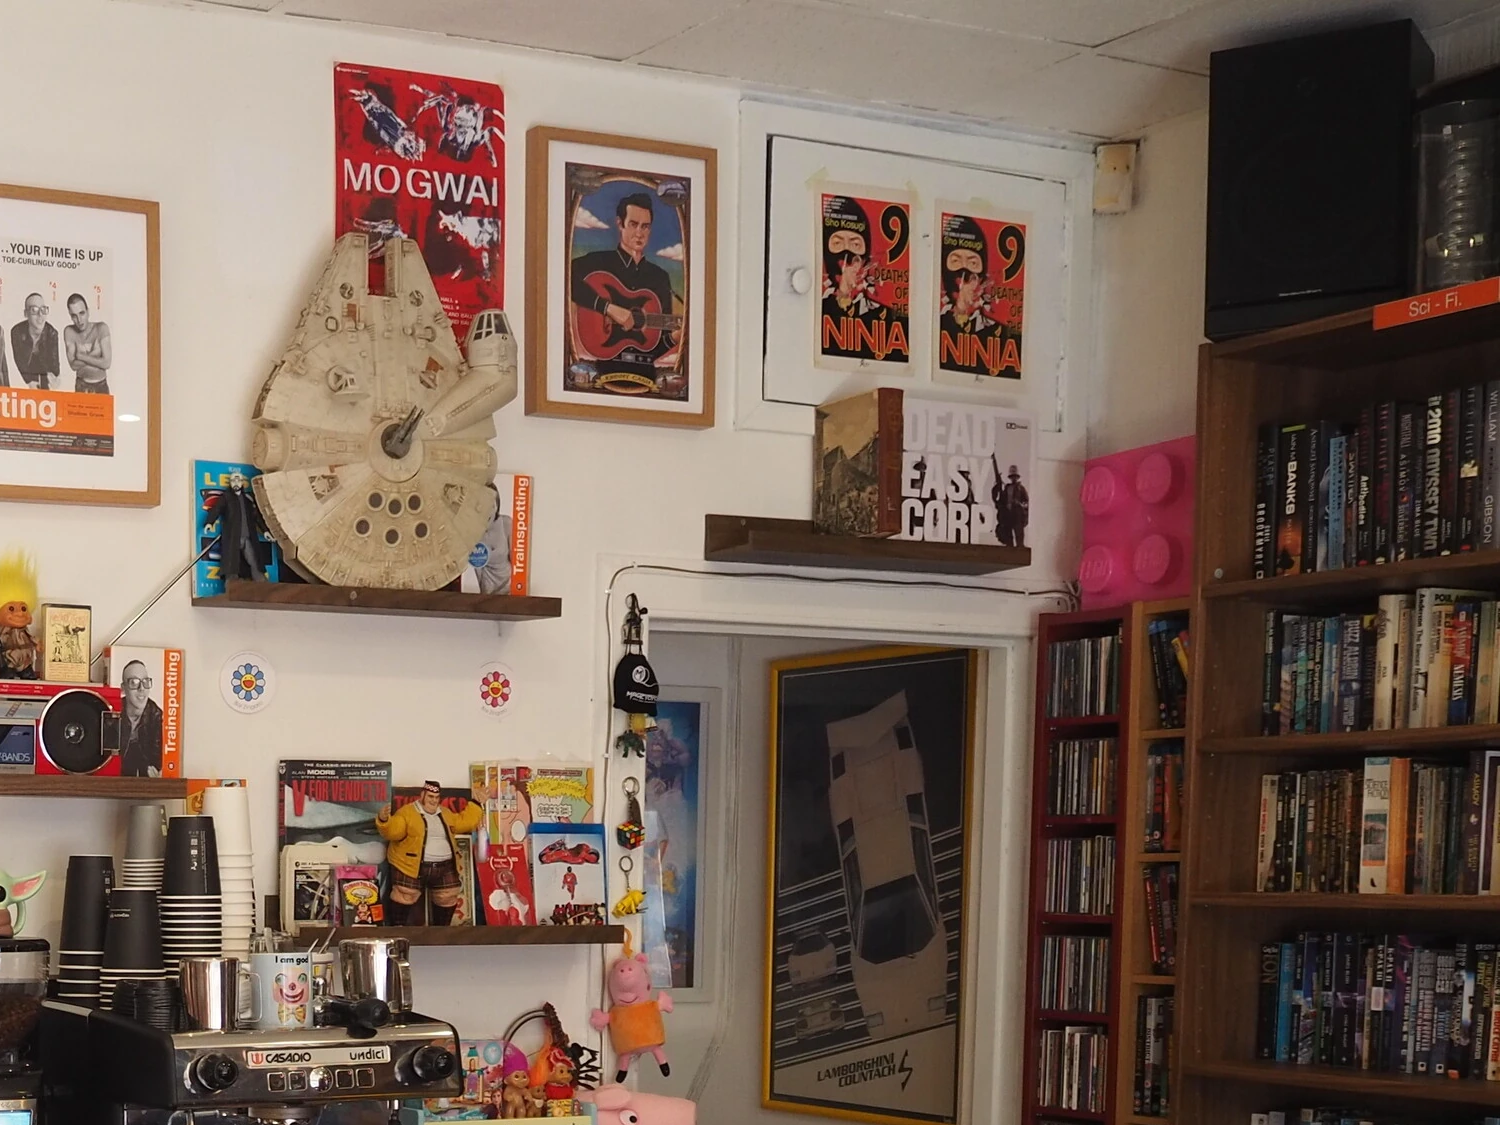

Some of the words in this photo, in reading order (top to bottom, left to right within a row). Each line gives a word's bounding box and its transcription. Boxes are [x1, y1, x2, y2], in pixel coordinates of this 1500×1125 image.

[342, 158, 499, 208] MOGWAI
[44, 246, 71, 259] TIME
[74, 249, 85, 260] IS
[88, 251, 104, 262] UP
[880, 204, 910, 264] 9
[997, 224, 1025, 283] 9
[2, 255, 55, 268] TOE-CURLINGLY
[1409, 302, 1430, 317] Sci
[1445, 292, 1462, 308] Fi.
[903, 409, 995, 458] DEAD
[1488, 390, 1499, 442] WILLIAM
[902, 452, 994, 504] EASY
[1286, 461, 1298, 515] BANKS
[513, 476, 529, 577] Trainspotting
[901, 499, 998, 544] CORP
[1484, 495, 1494, 544] GIBSON
[164, 651, 180, 755] Trainspotting
[292, 780, 307, 817] V
[309, 780, 328, 801] FOR
[331, 781, 387, 802] VENDETTA
[296, 955, 309, 965] god
[266, 1052, 311, 1063] CASADIO
[817, 1052, 894, 1081] LAMBORGHINI
[839, 1064, 896, 1087] COUNTACH
